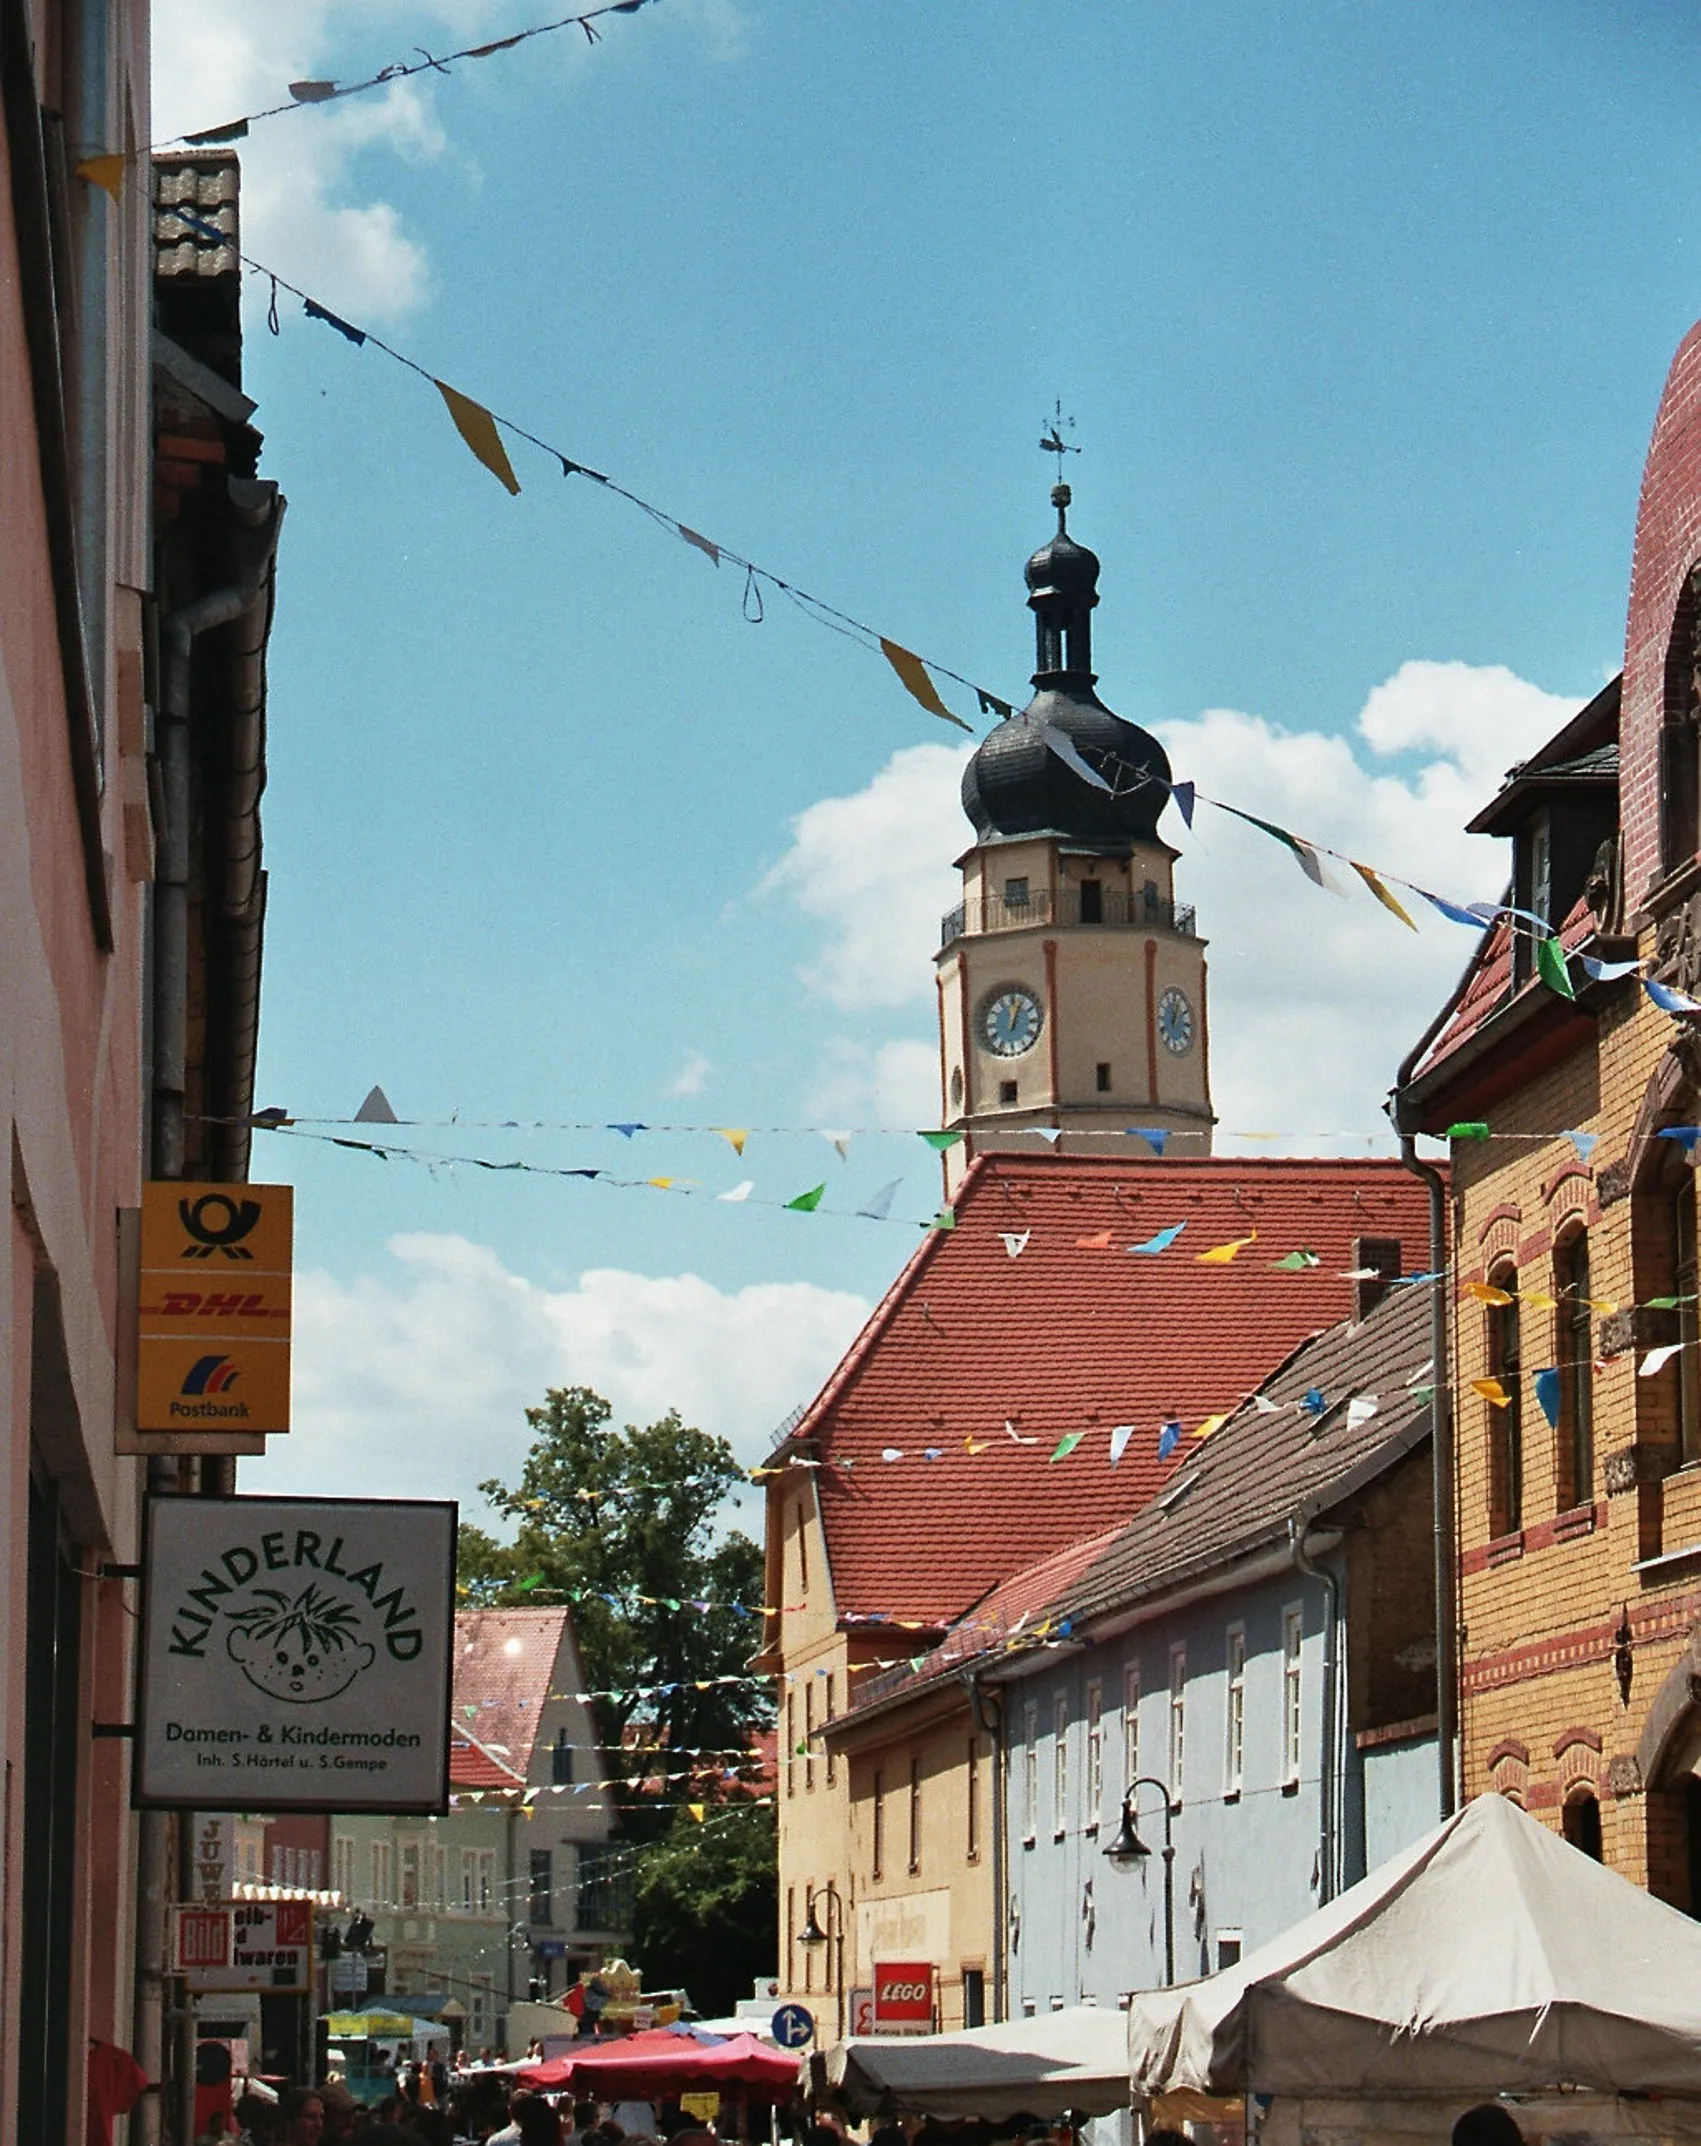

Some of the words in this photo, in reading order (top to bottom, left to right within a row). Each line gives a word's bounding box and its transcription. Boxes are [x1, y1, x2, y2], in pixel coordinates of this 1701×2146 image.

[161, 1293, 268, 1316] DHL
[170, 1401, 249, 1418] Postbank
[168, 1530, 423, 1661] KINDERLAND
[166, 1723, 250, 1743] Damen-
[257, 1724, 273, 1744] &
[281, 1727, 421, 1748] Kindermoden
[185, 1918, 223, 1961] Bild
[881, 1983, 927, 2001] LEGO
